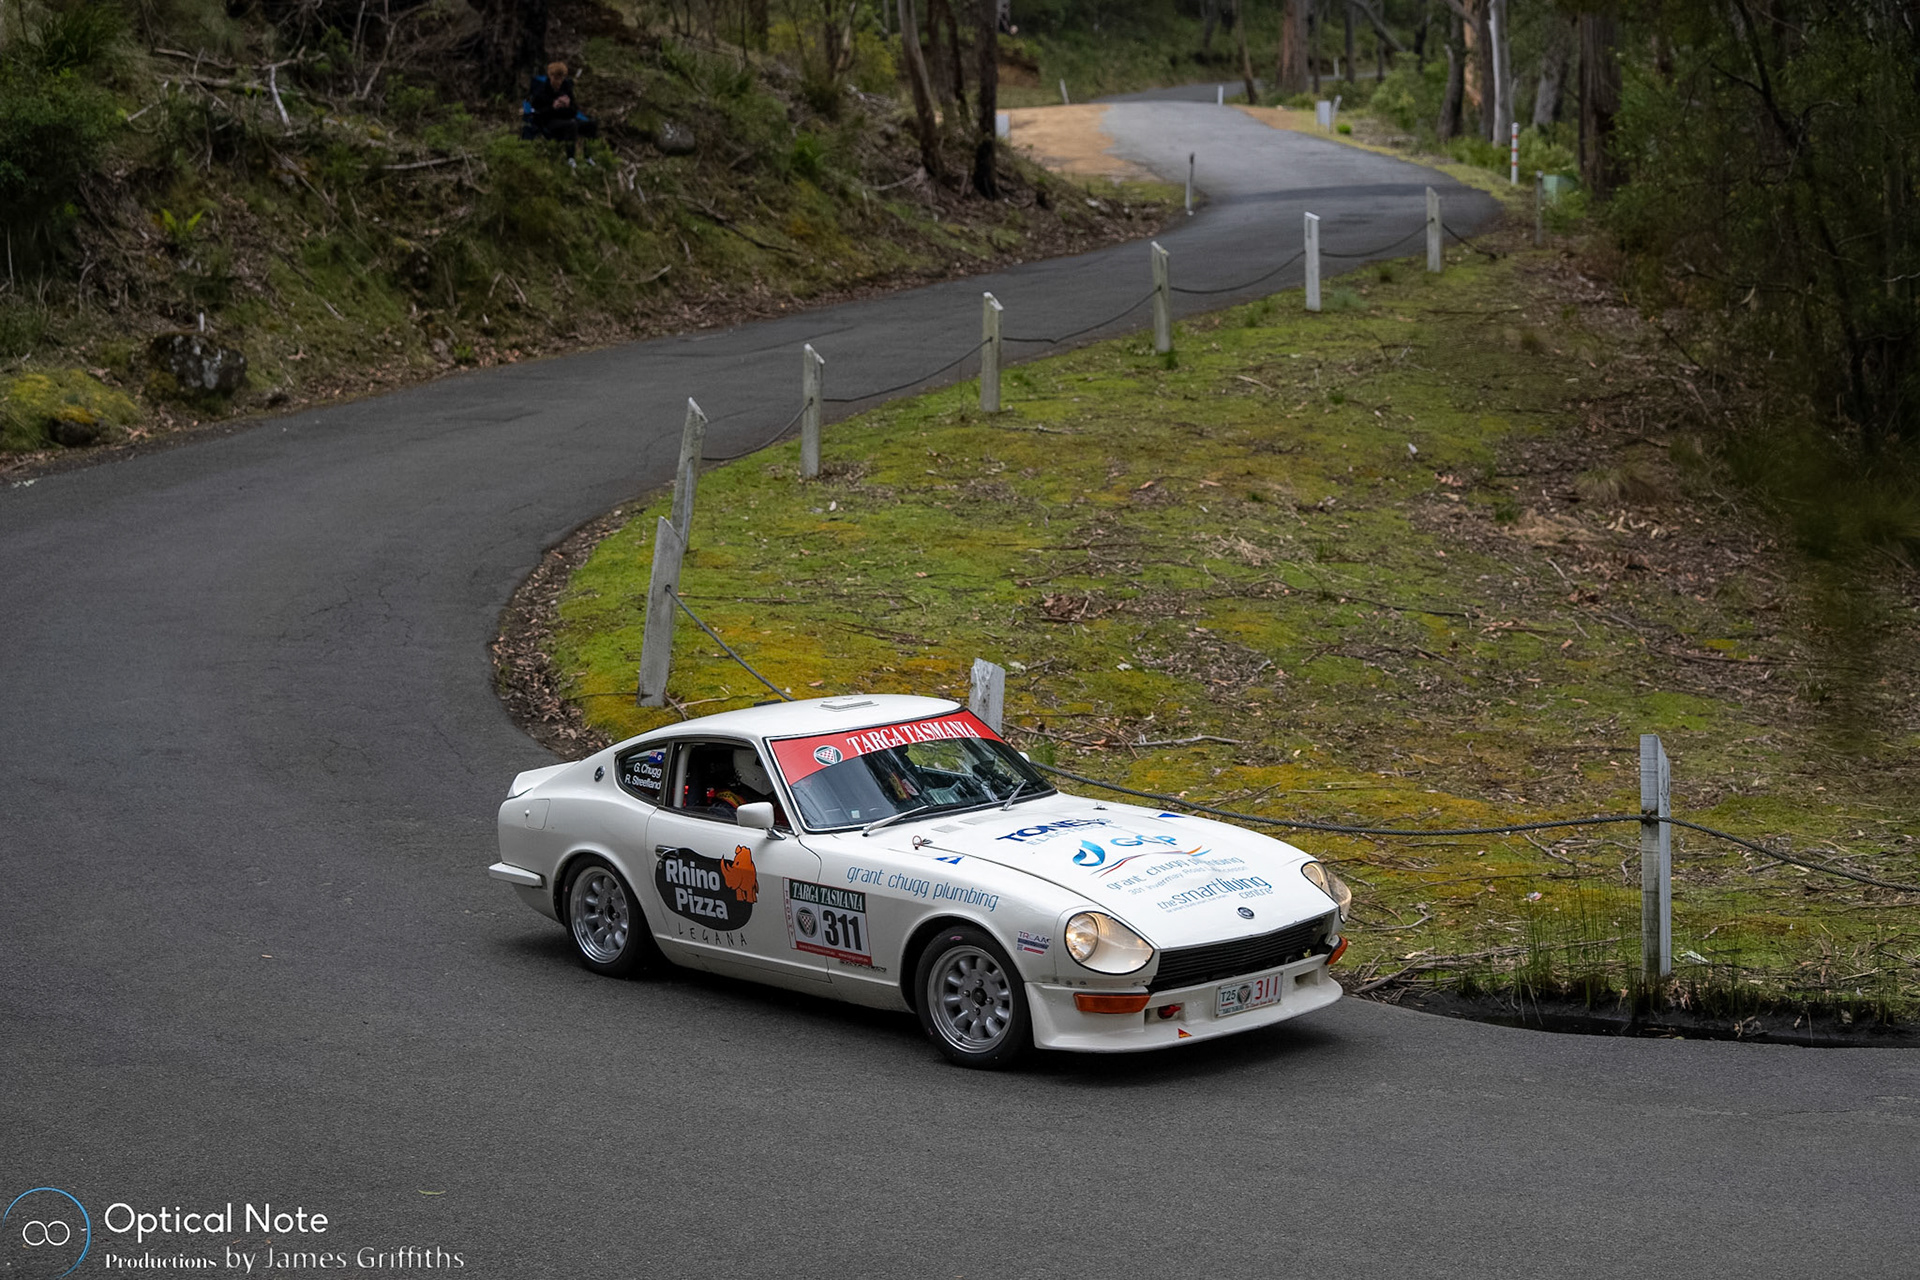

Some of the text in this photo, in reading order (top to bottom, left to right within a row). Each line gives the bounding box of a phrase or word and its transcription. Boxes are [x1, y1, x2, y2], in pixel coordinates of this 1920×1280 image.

[846, 720, 980, 755] TARGA TASMANIA
[633, 762, 662, 779] G. Chugg
[665, 858, 720, 891] Rhino
[846, 866, 1000, 912] grant chugg plumbing
[1106, 874, 1147, 891] grant
[1146, 858, 1190, 876] chugg
[675, 887, 728, 920] Pizza
[792, 882, 864, 911] TARGA TASMANIA
[1239, 887, 1273, 900] centre
[678, 922, 748, 947] LEGANA
[823, 909, 863, 951] 311
[1221, 976, 1278, 1002] T25 311
